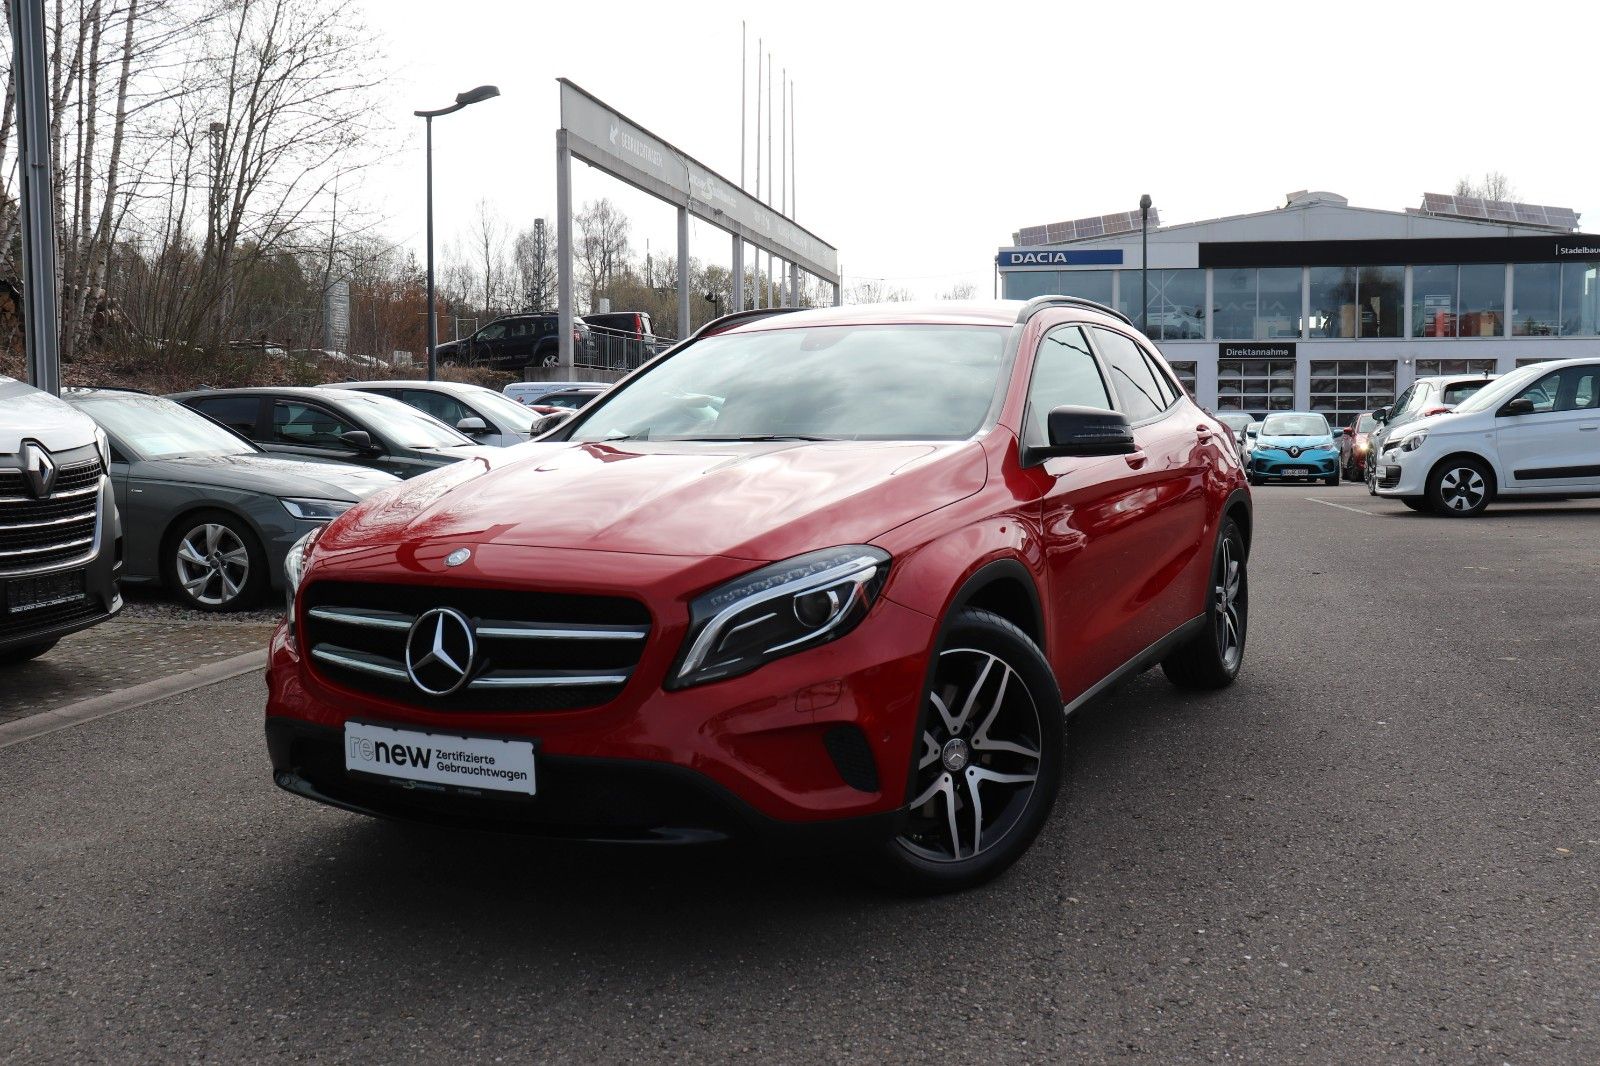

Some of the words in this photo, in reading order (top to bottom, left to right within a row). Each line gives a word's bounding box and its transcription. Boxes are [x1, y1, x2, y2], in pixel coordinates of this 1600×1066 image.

[1560, 246, 1600, 255] Stadelbau
[1011, 252, 1068, 264] DACIA
[1226, 348, 1289, 357] Direktannahme
[350, 736, 432, 769] renew
[435, 749, 496, 765] Zertifizierte
[436, 761, 528, 782] Gebrauchtwagen
